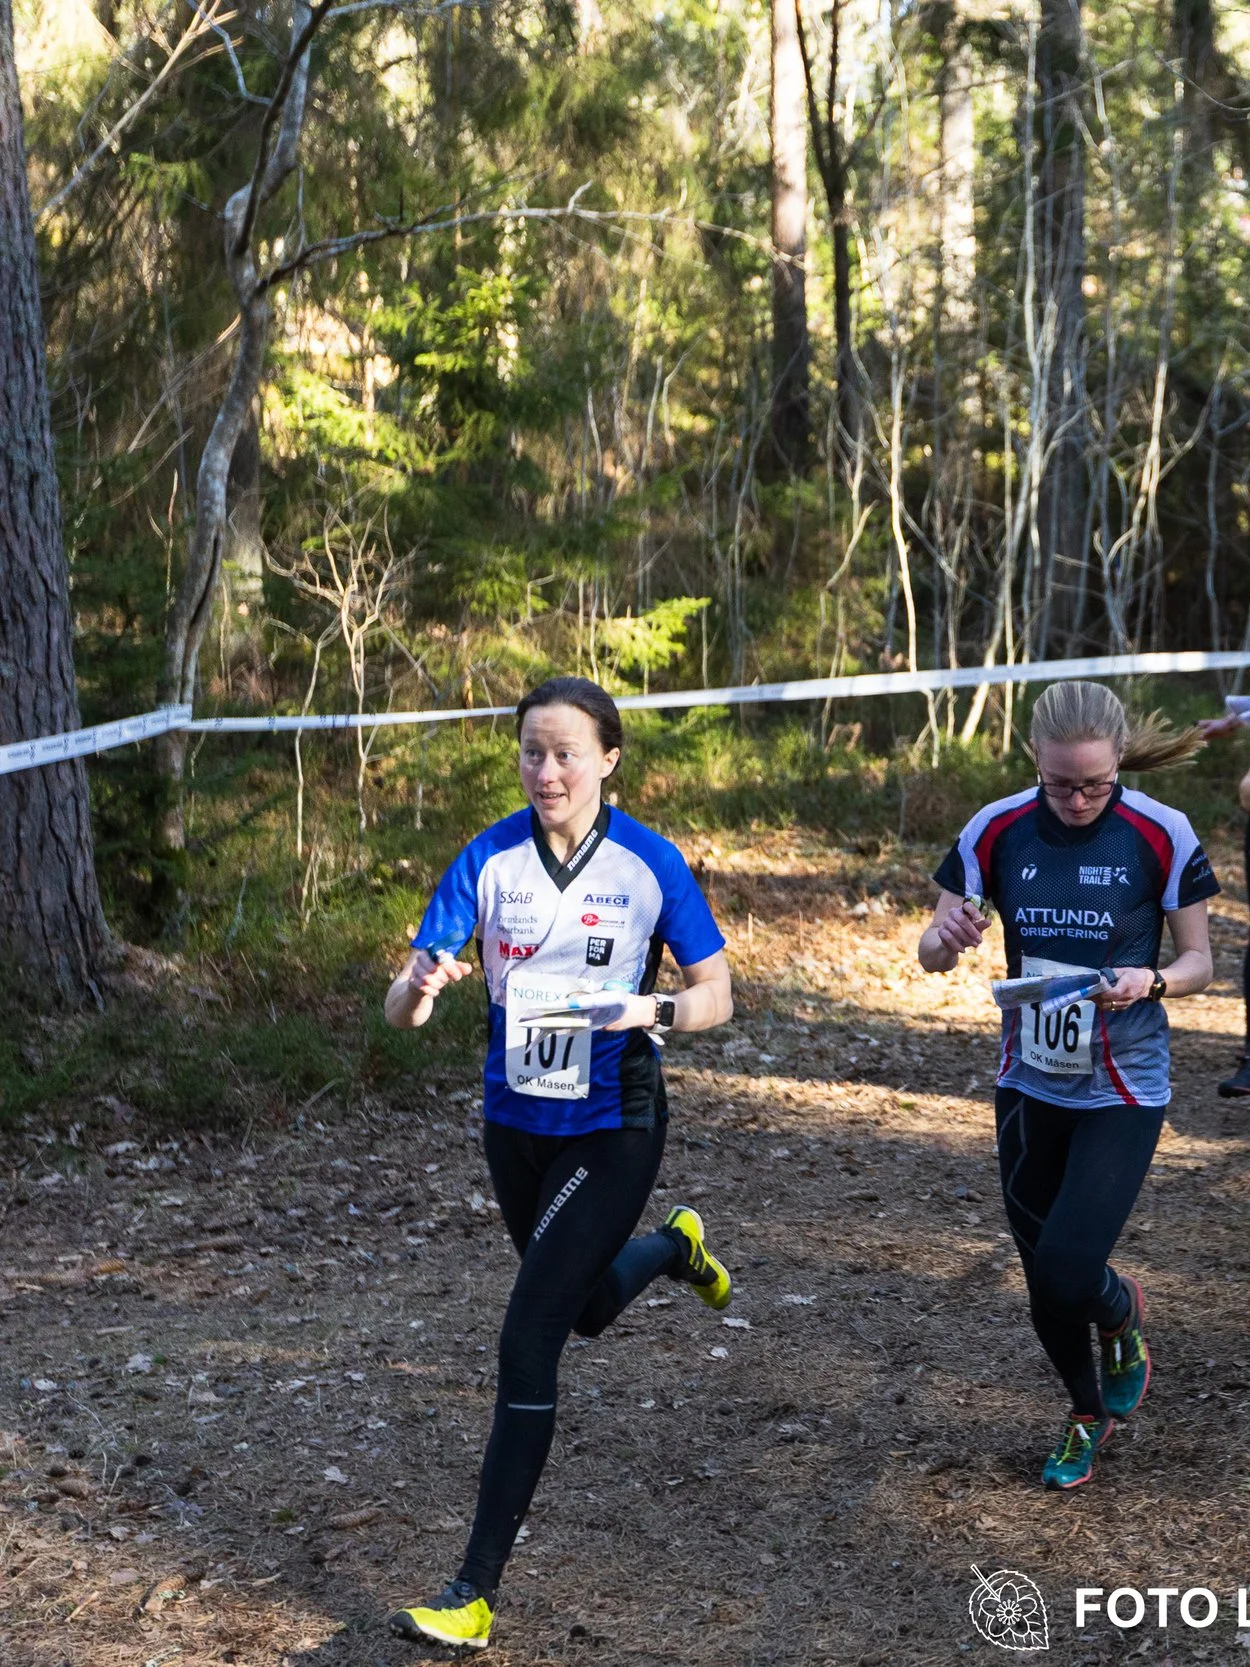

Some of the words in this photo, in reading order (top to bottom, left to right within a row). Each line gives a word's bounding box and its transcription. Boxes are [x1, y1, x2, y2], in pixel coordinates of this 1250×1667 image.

[1079, 866, 1103, 876] NIGHT
[1102, 866, 1112, 886] RUN
[1079, 875, 1102, 885] TRAIL
[499, 890, 534, 905] SSAB
[583, 894, 630, 906] ABECE
[1015, 907, 1115, 928] ATTUNDA
[1020, 927, 1109, 940] ORIENTERING
[589, 946, 605, 954] FOR
[590, 938, 607, 947] PER
[588, 952, 601, 961] MA
[1030, 1002, 1082, 1053] 106
[1030, 1051, 1043, 1062] OK
[1045, 1057, 1079, 1069] Måsen
[516, 1074, 534, 1086] OK
[537, 1077, 575, 1092] Måsen
[533, 1166, 589, 1241] noname
